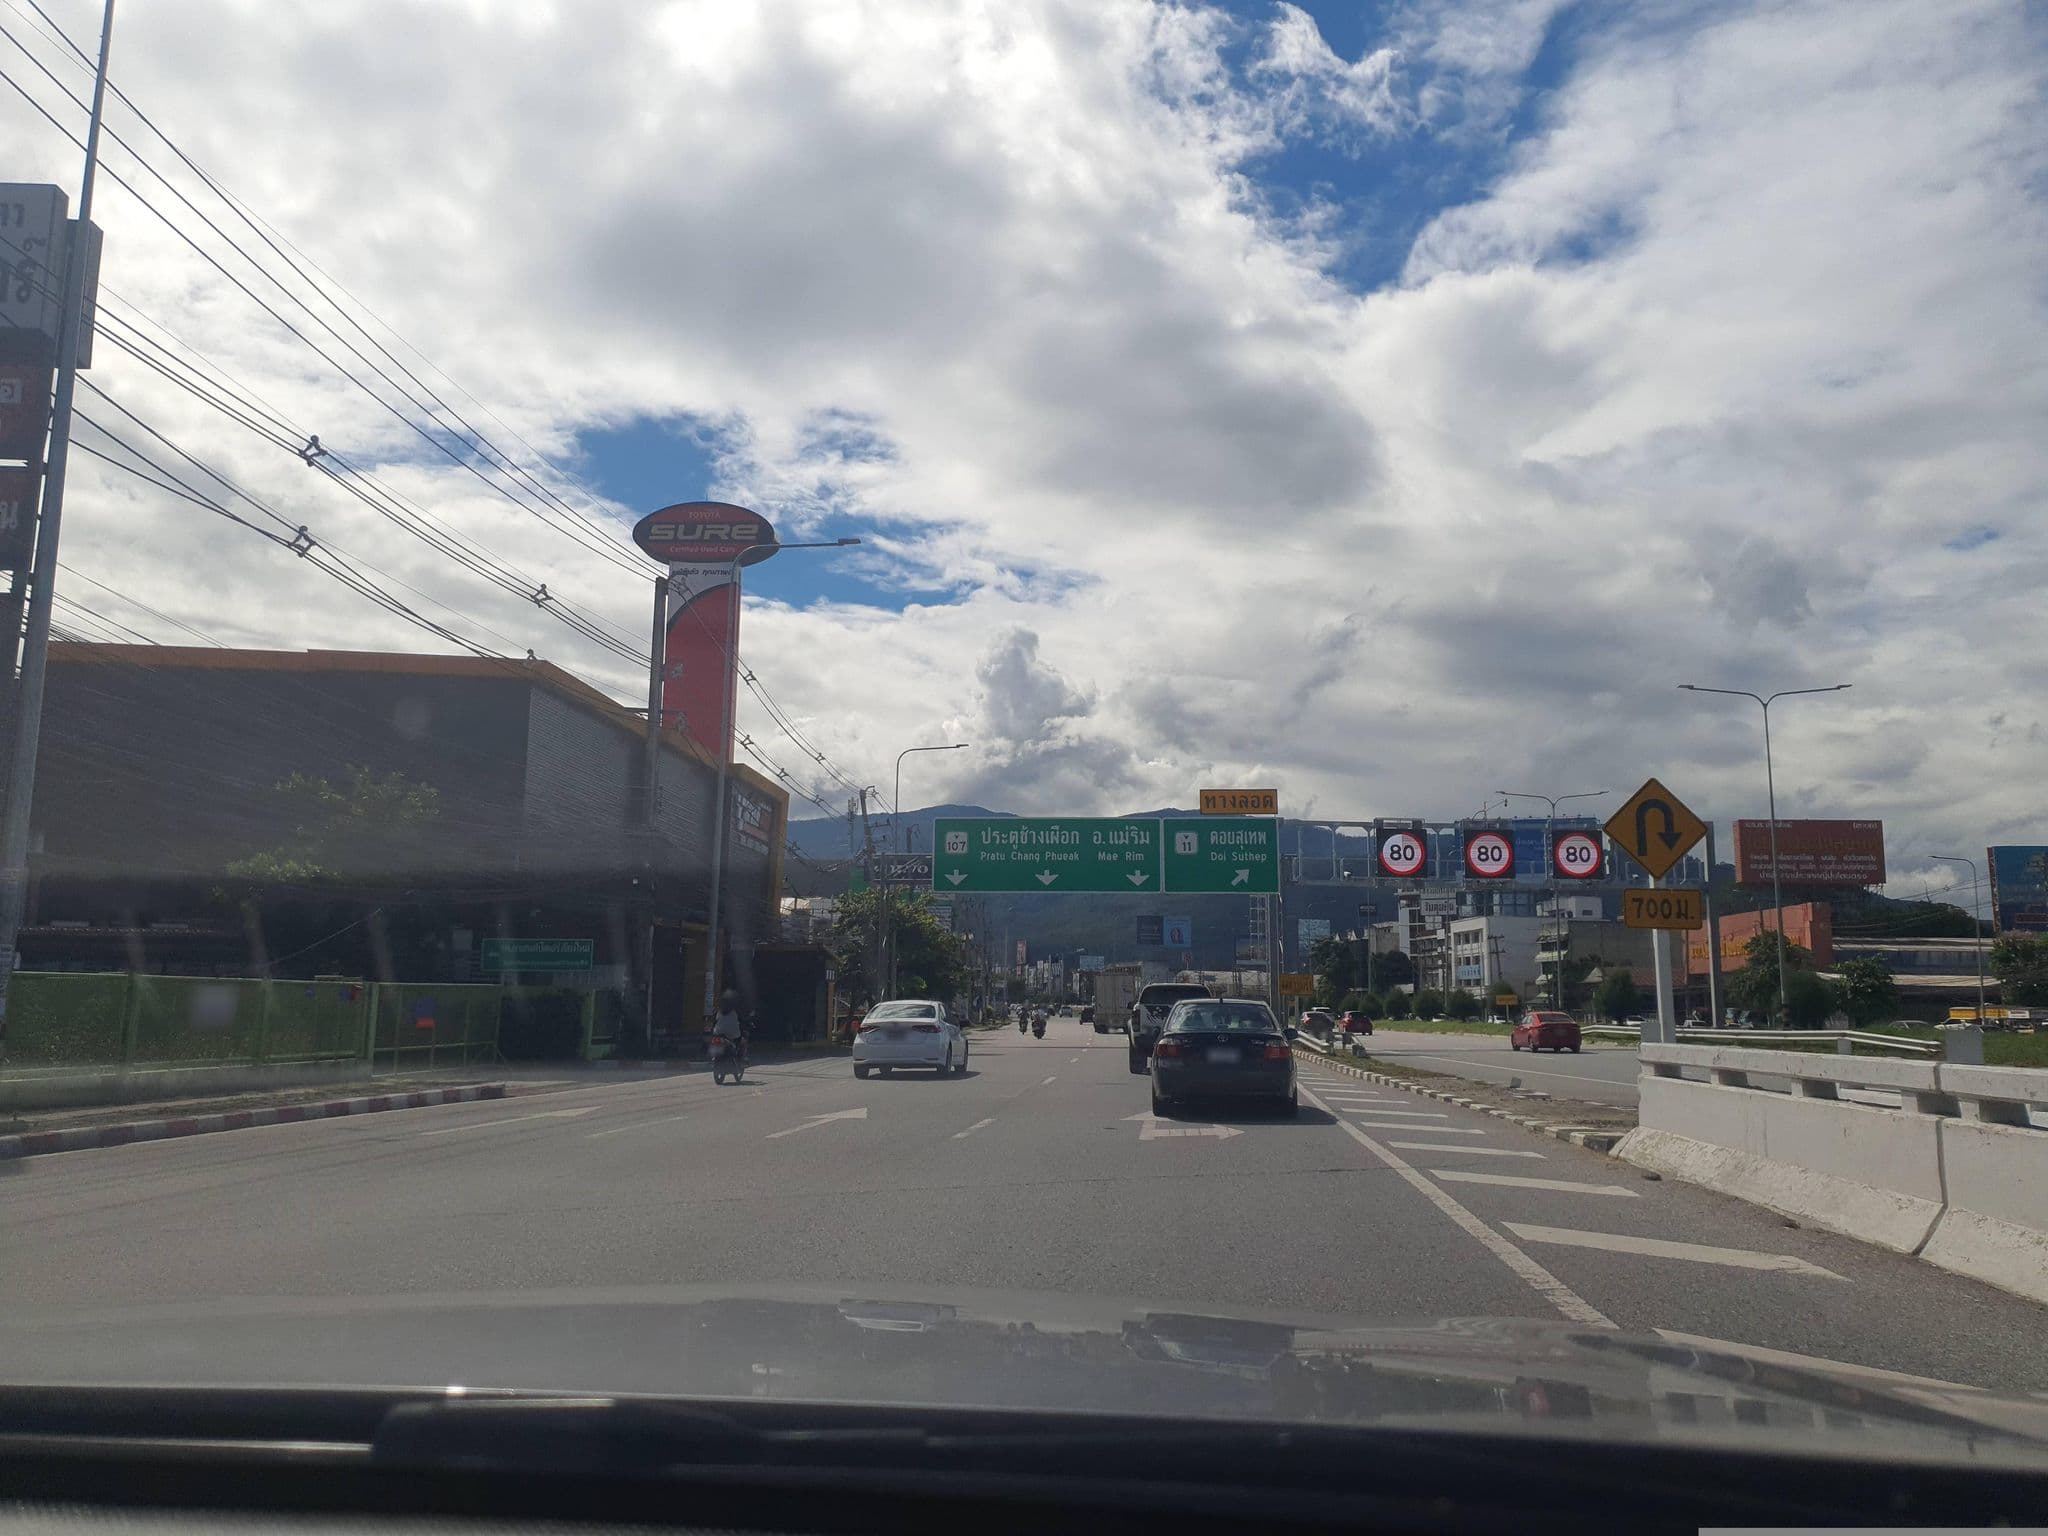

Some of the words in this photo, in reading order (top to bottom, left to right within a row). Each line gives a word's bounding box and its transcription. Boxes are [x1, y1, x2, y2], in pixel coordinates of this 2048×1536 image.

[688, 511, 720, 520] TOYOTA
[649, 523, 759, 541] SURE
[1205, 795, 1274, 809] ทางลอด
[981, 825, 1080, 849] ประตูช้างเผือก
[1210, 830, 1267, 850] ดอยสุเทพ
[946, 841, 967, 852] 107
[1182, 842, 1192, 852] 11
[1390, 844, 1415, 862] 80
[1477, 845, 1503, 862] 80
[1565, 845, 1591, 863] 80
[980, 852, 1006, 862] Pratu
[1011, 852, 1040, 863] Chang
[1045, 852, 1080, 862] Phueak
[1098, 852, 1118, 862] Mae
[1126, 852, 1145, 862] Rim
[1210, 852, 1226, 862] Doi
[1231, 852, 1267, 863] Suthep
